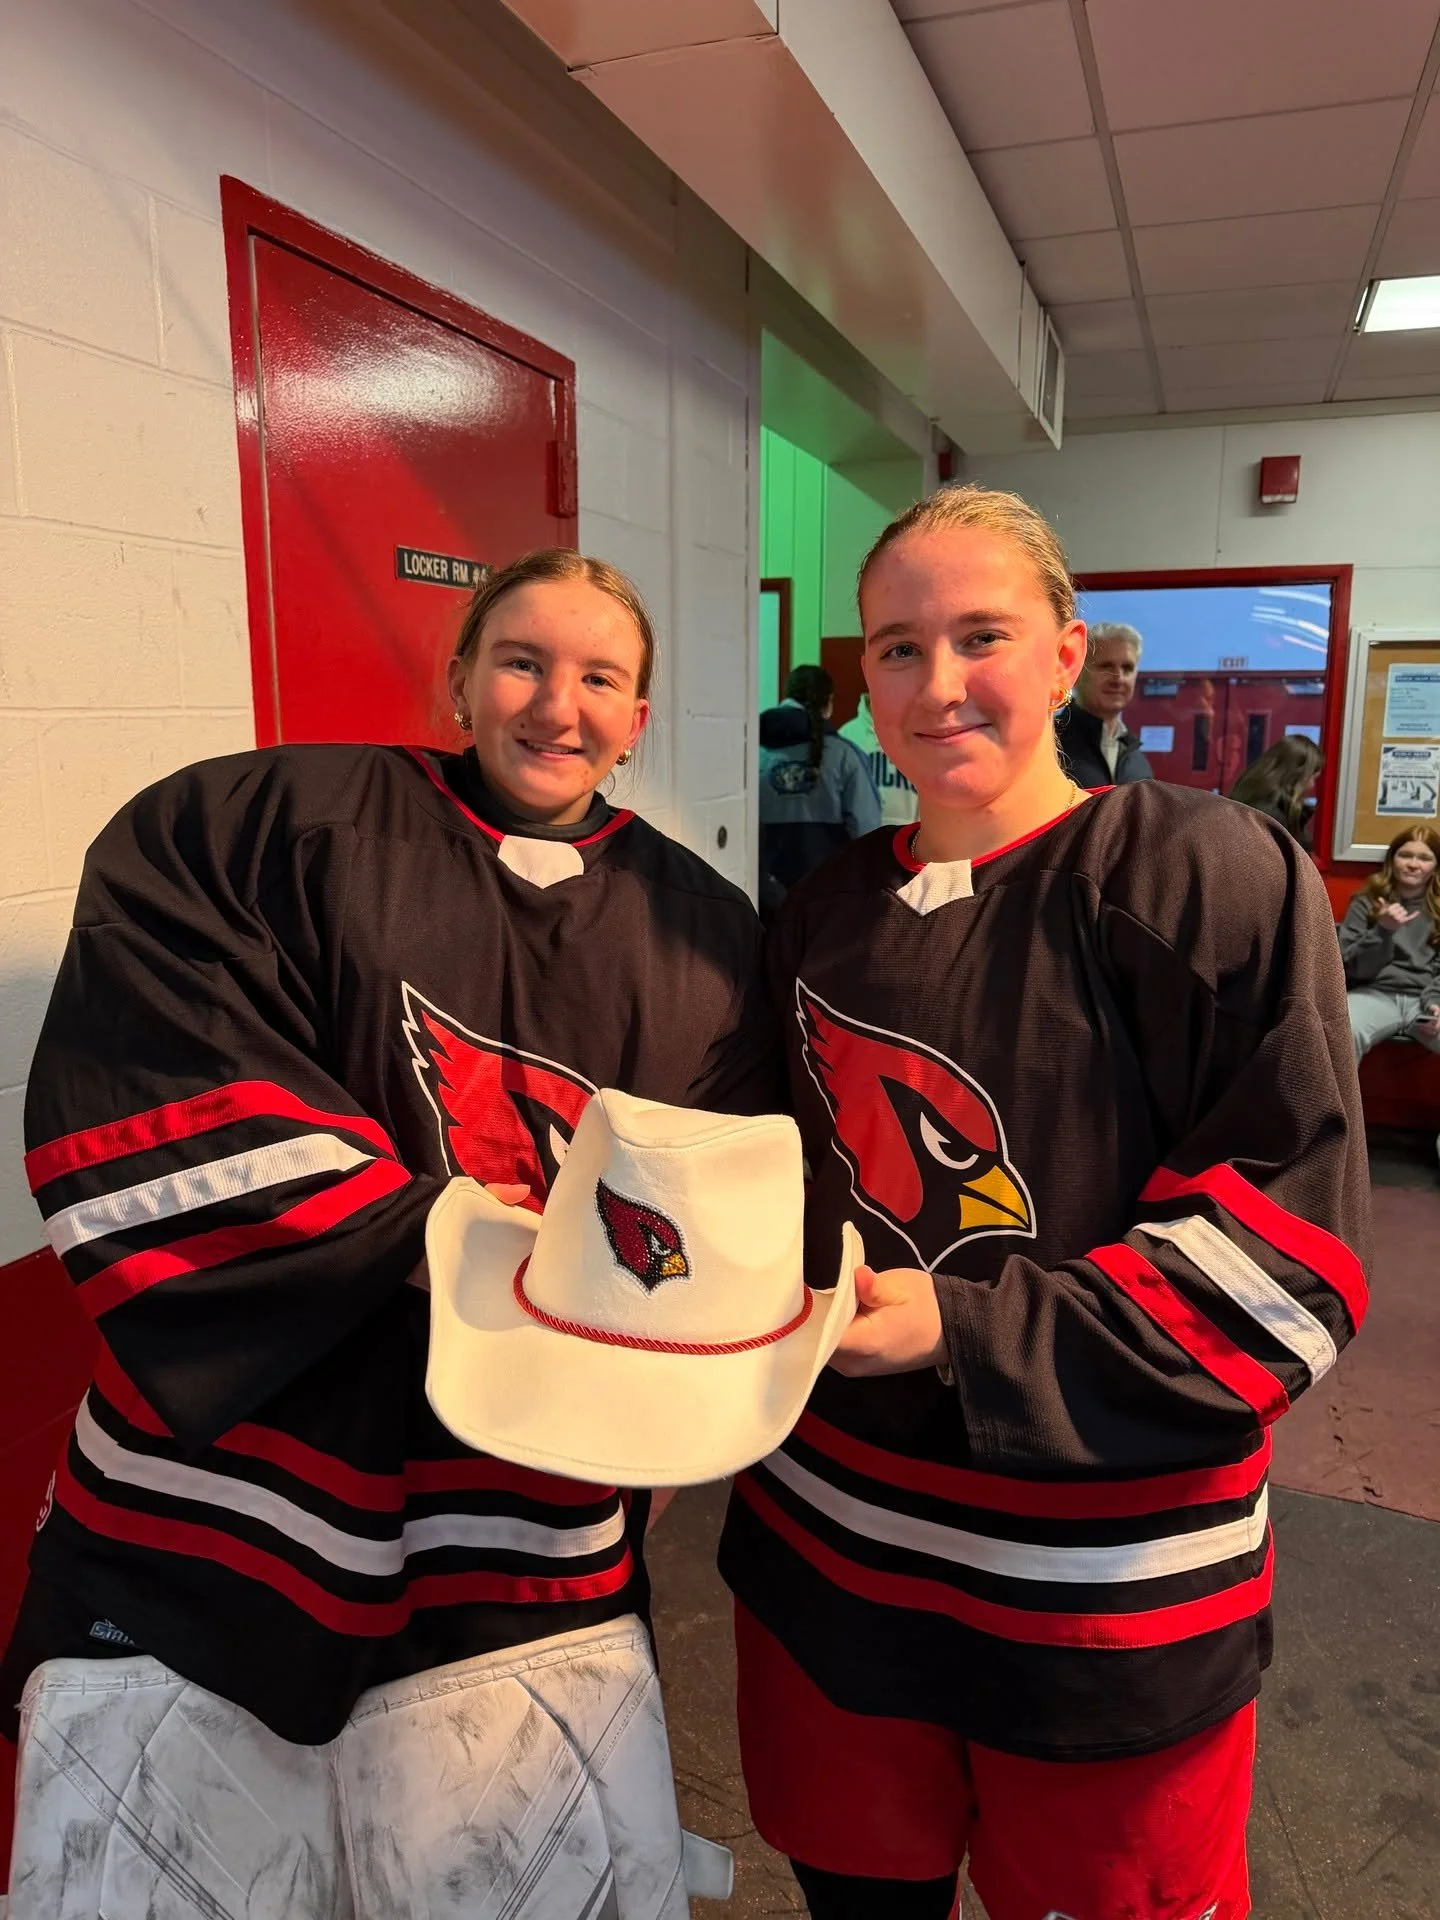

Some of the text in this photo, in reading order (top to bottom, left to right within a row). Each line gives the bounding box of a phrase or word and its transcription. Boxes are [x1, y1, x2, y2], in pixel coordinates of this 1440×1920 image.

[404, 552, 448, 580] LOCKER
[452, 562, 469, 583] RM
[1222, 657, 1245, 668] EXIT
